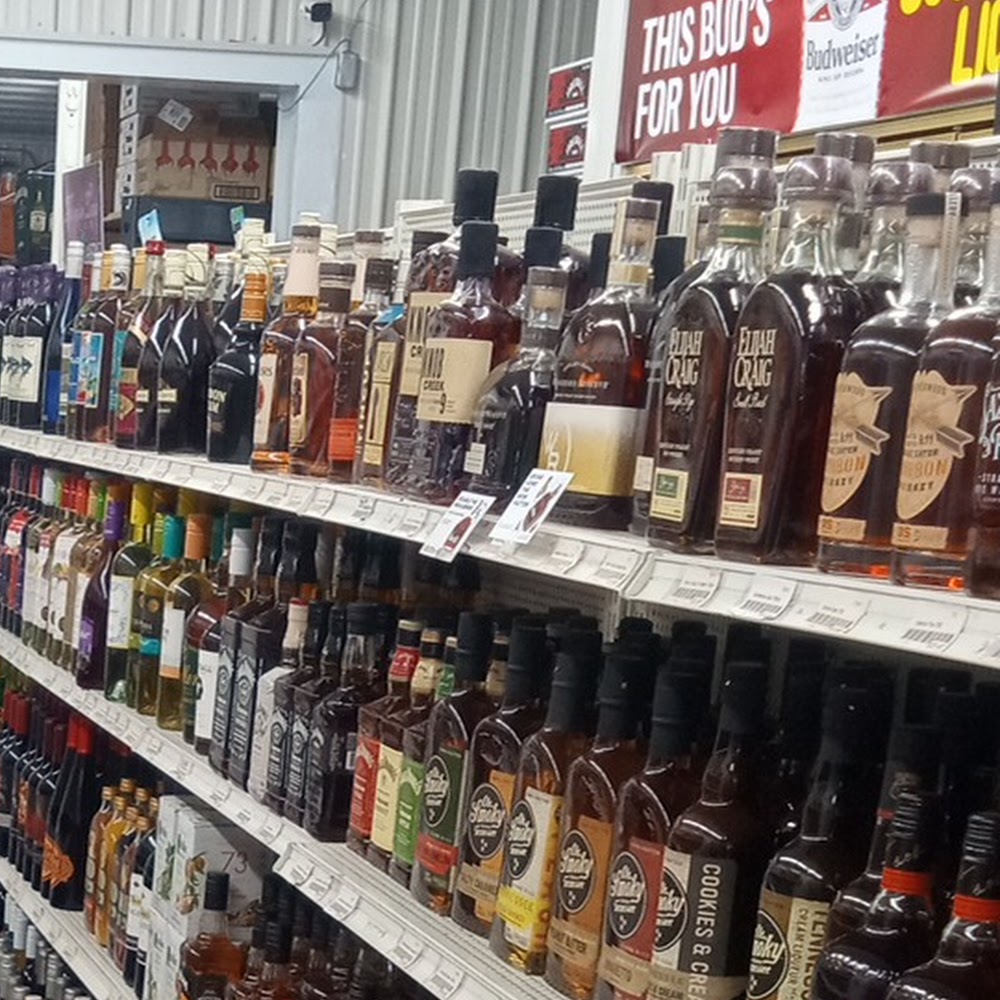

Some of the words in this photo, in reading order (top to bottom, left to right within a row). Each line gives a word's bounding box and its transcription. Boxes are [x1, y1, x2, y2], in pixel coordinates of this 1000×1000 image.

[642, 6, 695, 75] THIS
[699, 0, 772, 62] BUD'S
[806, 34, 880, 71] Budweiser
[634, 77, 684, 140] FOR
[689, 63, 738, 130] YOU
[669, 327, 703, 356] ELIJAH
[736, 327, 777, 357] ELIJAH
[665, 356, 700, 389] CRAIG
[733, 356, 772, 391] CRAIG
[694, 863, 722, 938] COOKIES
[692, 943, 712, 956] &
